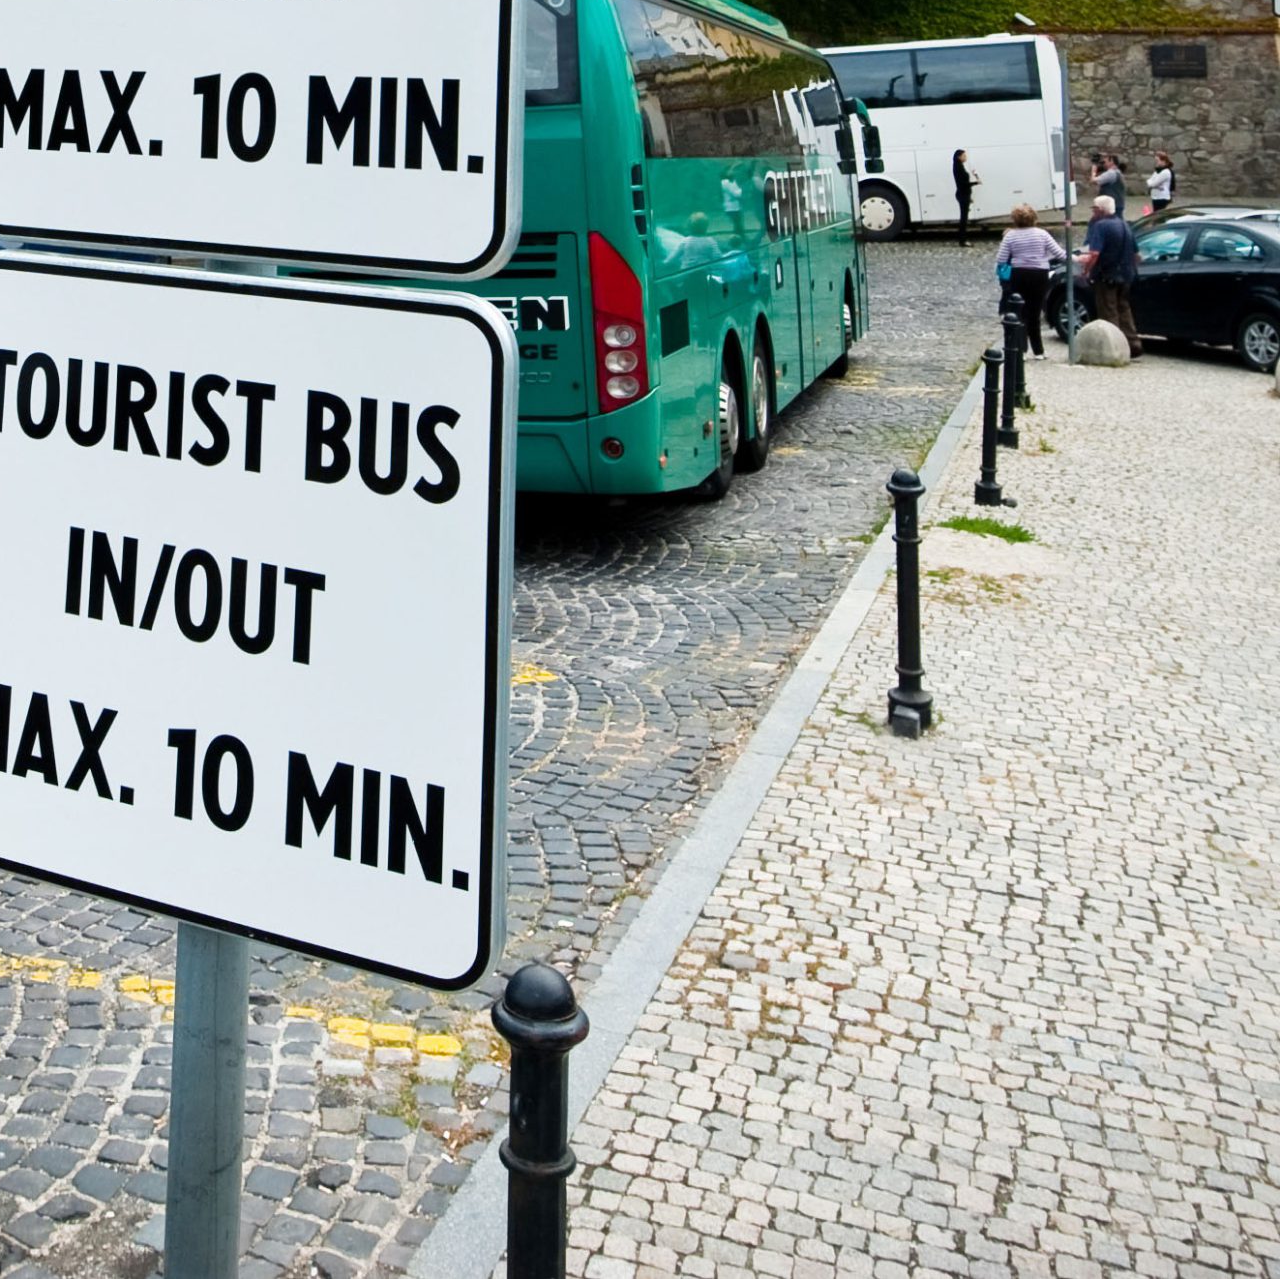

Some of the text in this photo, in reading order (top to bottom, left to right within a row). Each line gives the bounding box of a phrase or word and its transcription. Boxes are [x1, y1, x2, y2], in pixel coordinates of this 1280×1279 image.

[193, 72, 277, 163] 10
[306, 75, 484, 174] MIN.
[304, 389, 461, 505] BUS
[64, 526, 326, 666] IN/OUT
[167, 728, 255, 833] 10
[284, 750, 470, 892] MIN.
